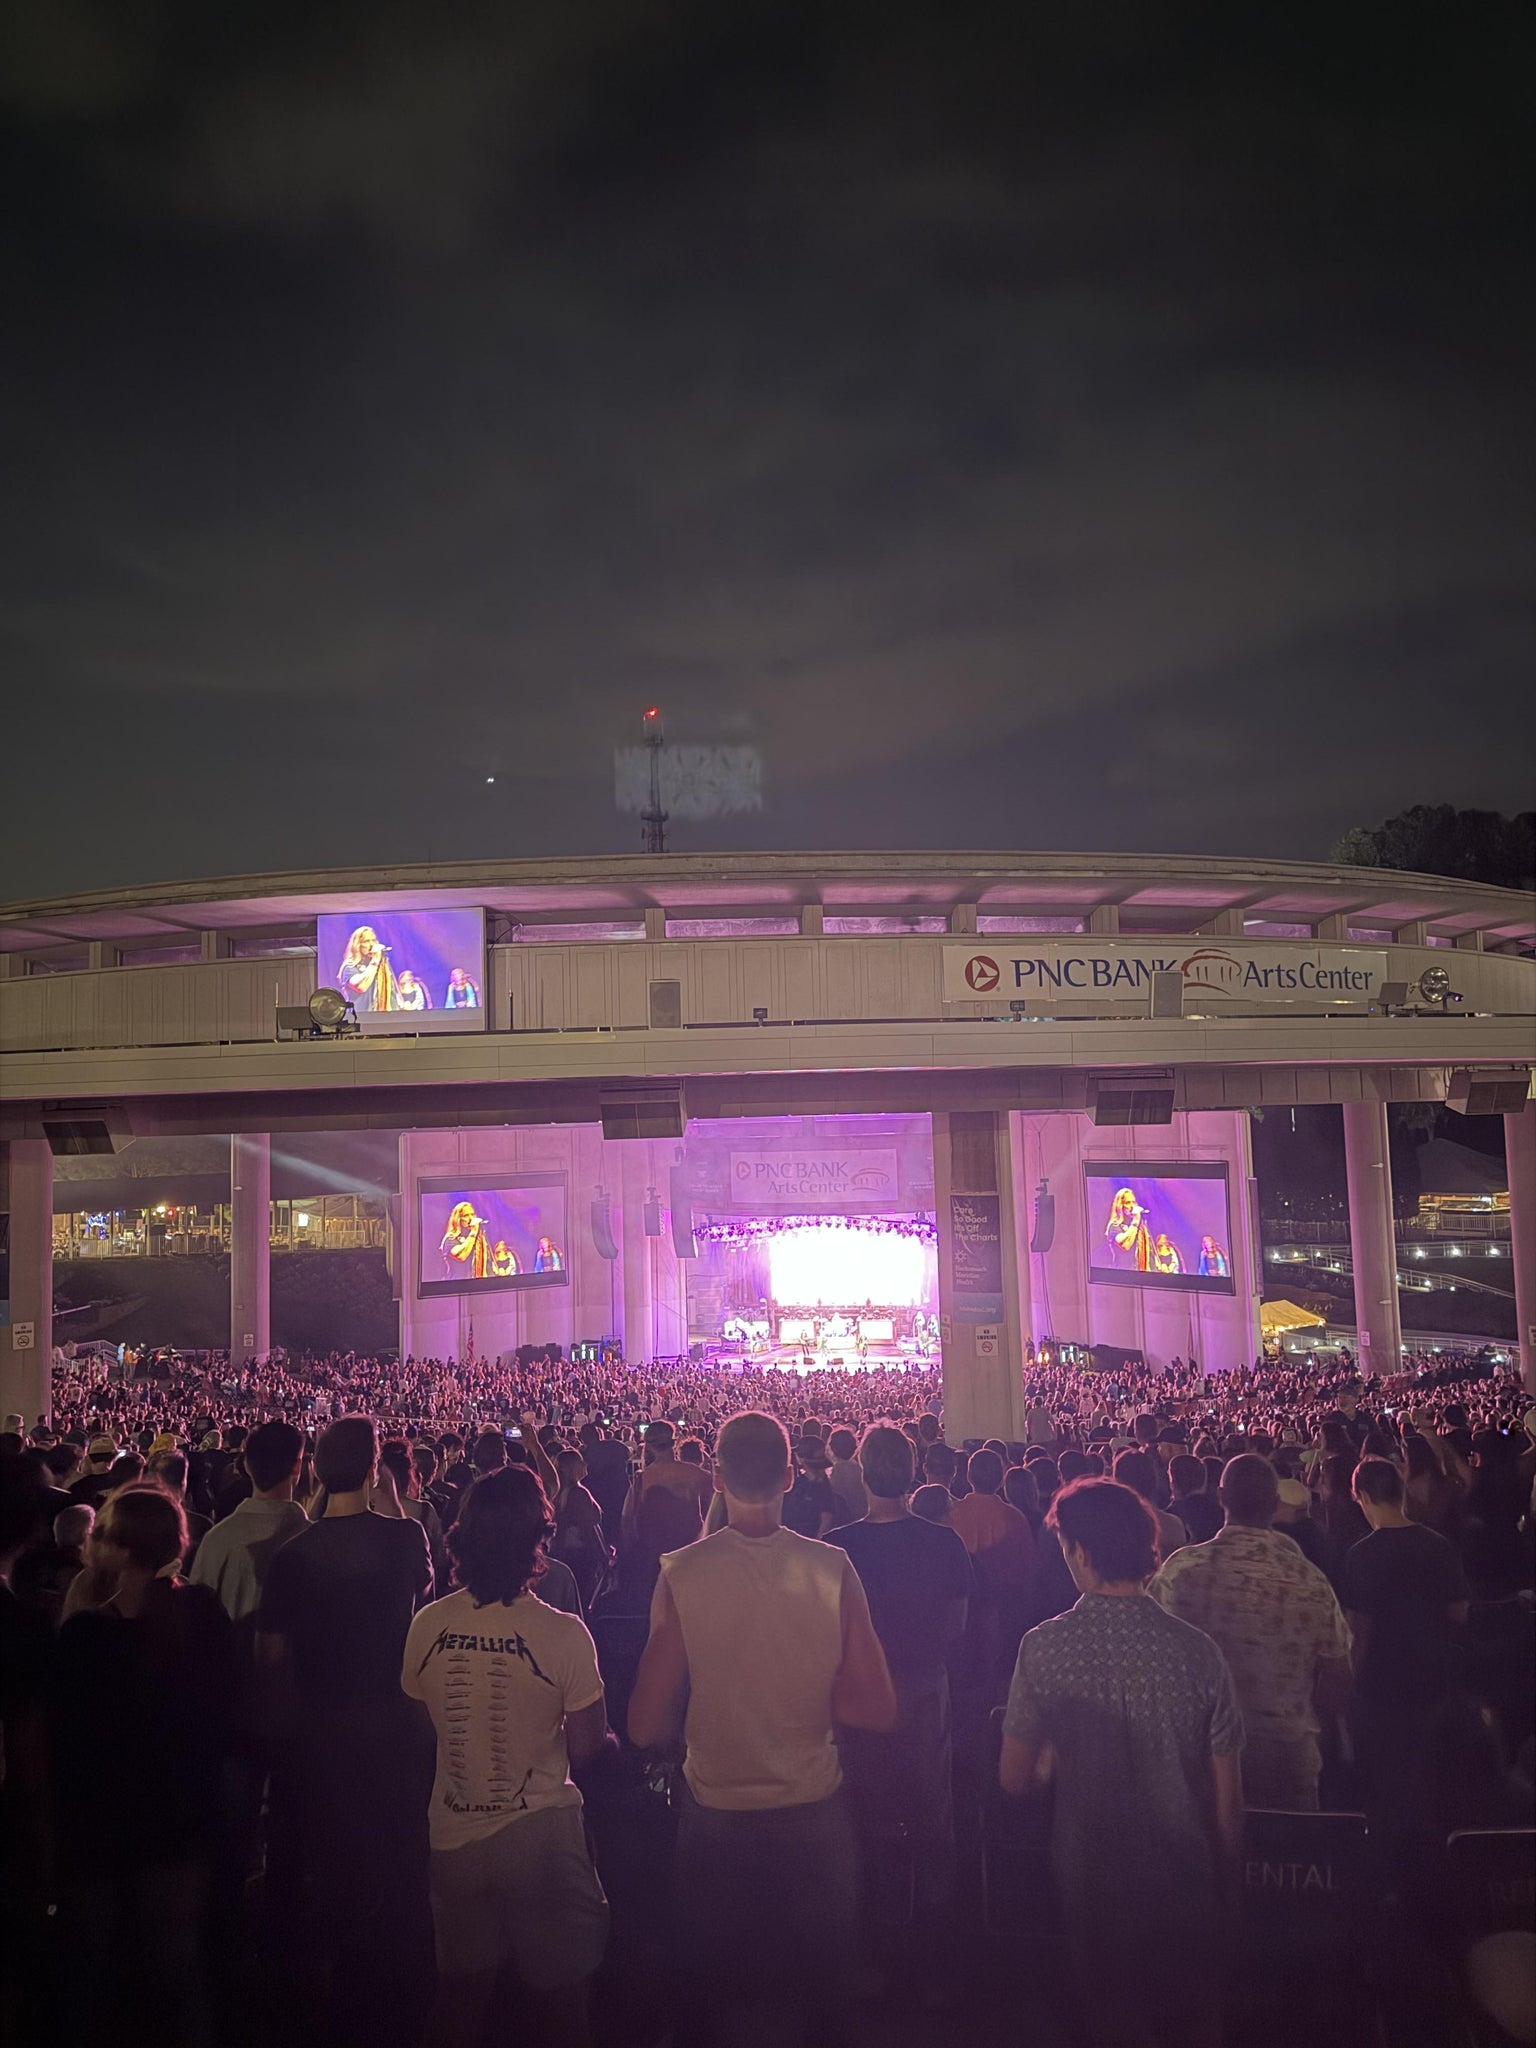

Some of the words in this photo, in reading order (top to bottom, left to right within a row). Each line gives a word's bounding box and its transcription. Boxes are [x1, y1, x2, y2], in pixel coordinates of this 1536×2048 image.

[953, 1206, 974, 1214] Care
[965, 1215, 988, 1223] Good
[970, 1233, 998, 1241] Charts
[1245, 1861, 1340, 1889] ENTAL
